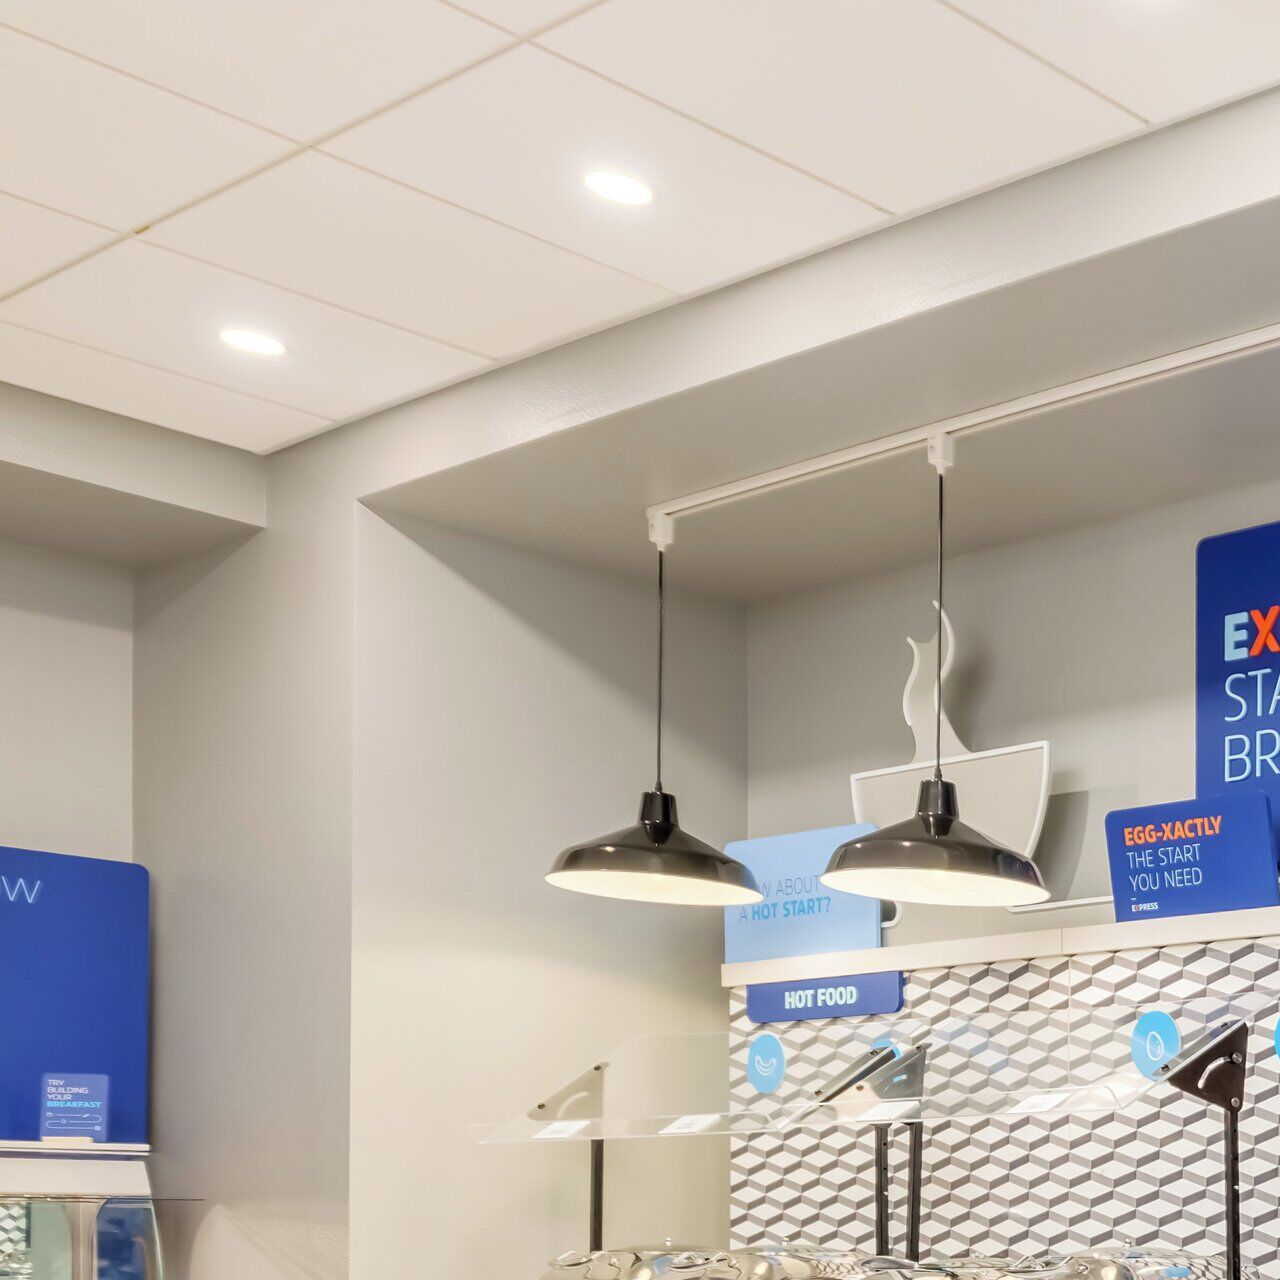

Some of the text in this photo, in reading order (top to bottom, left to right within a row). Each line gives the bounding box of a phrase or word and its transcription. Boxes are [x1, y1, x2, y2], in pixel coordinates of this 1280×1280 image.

[1124, 815, 1222, 846] EGG-XACTLY
[1126, 844, 1200, 869] THE START
[776, 875, 820, 896] ABOUT
[1129, 868, 1203, 891] YOU NEED
[739, 896, 832, 922] A HOT START?
[1132, 902, 1159, 912] EXPRESS
[784, 986, 857, 1009] HOT FOOD
